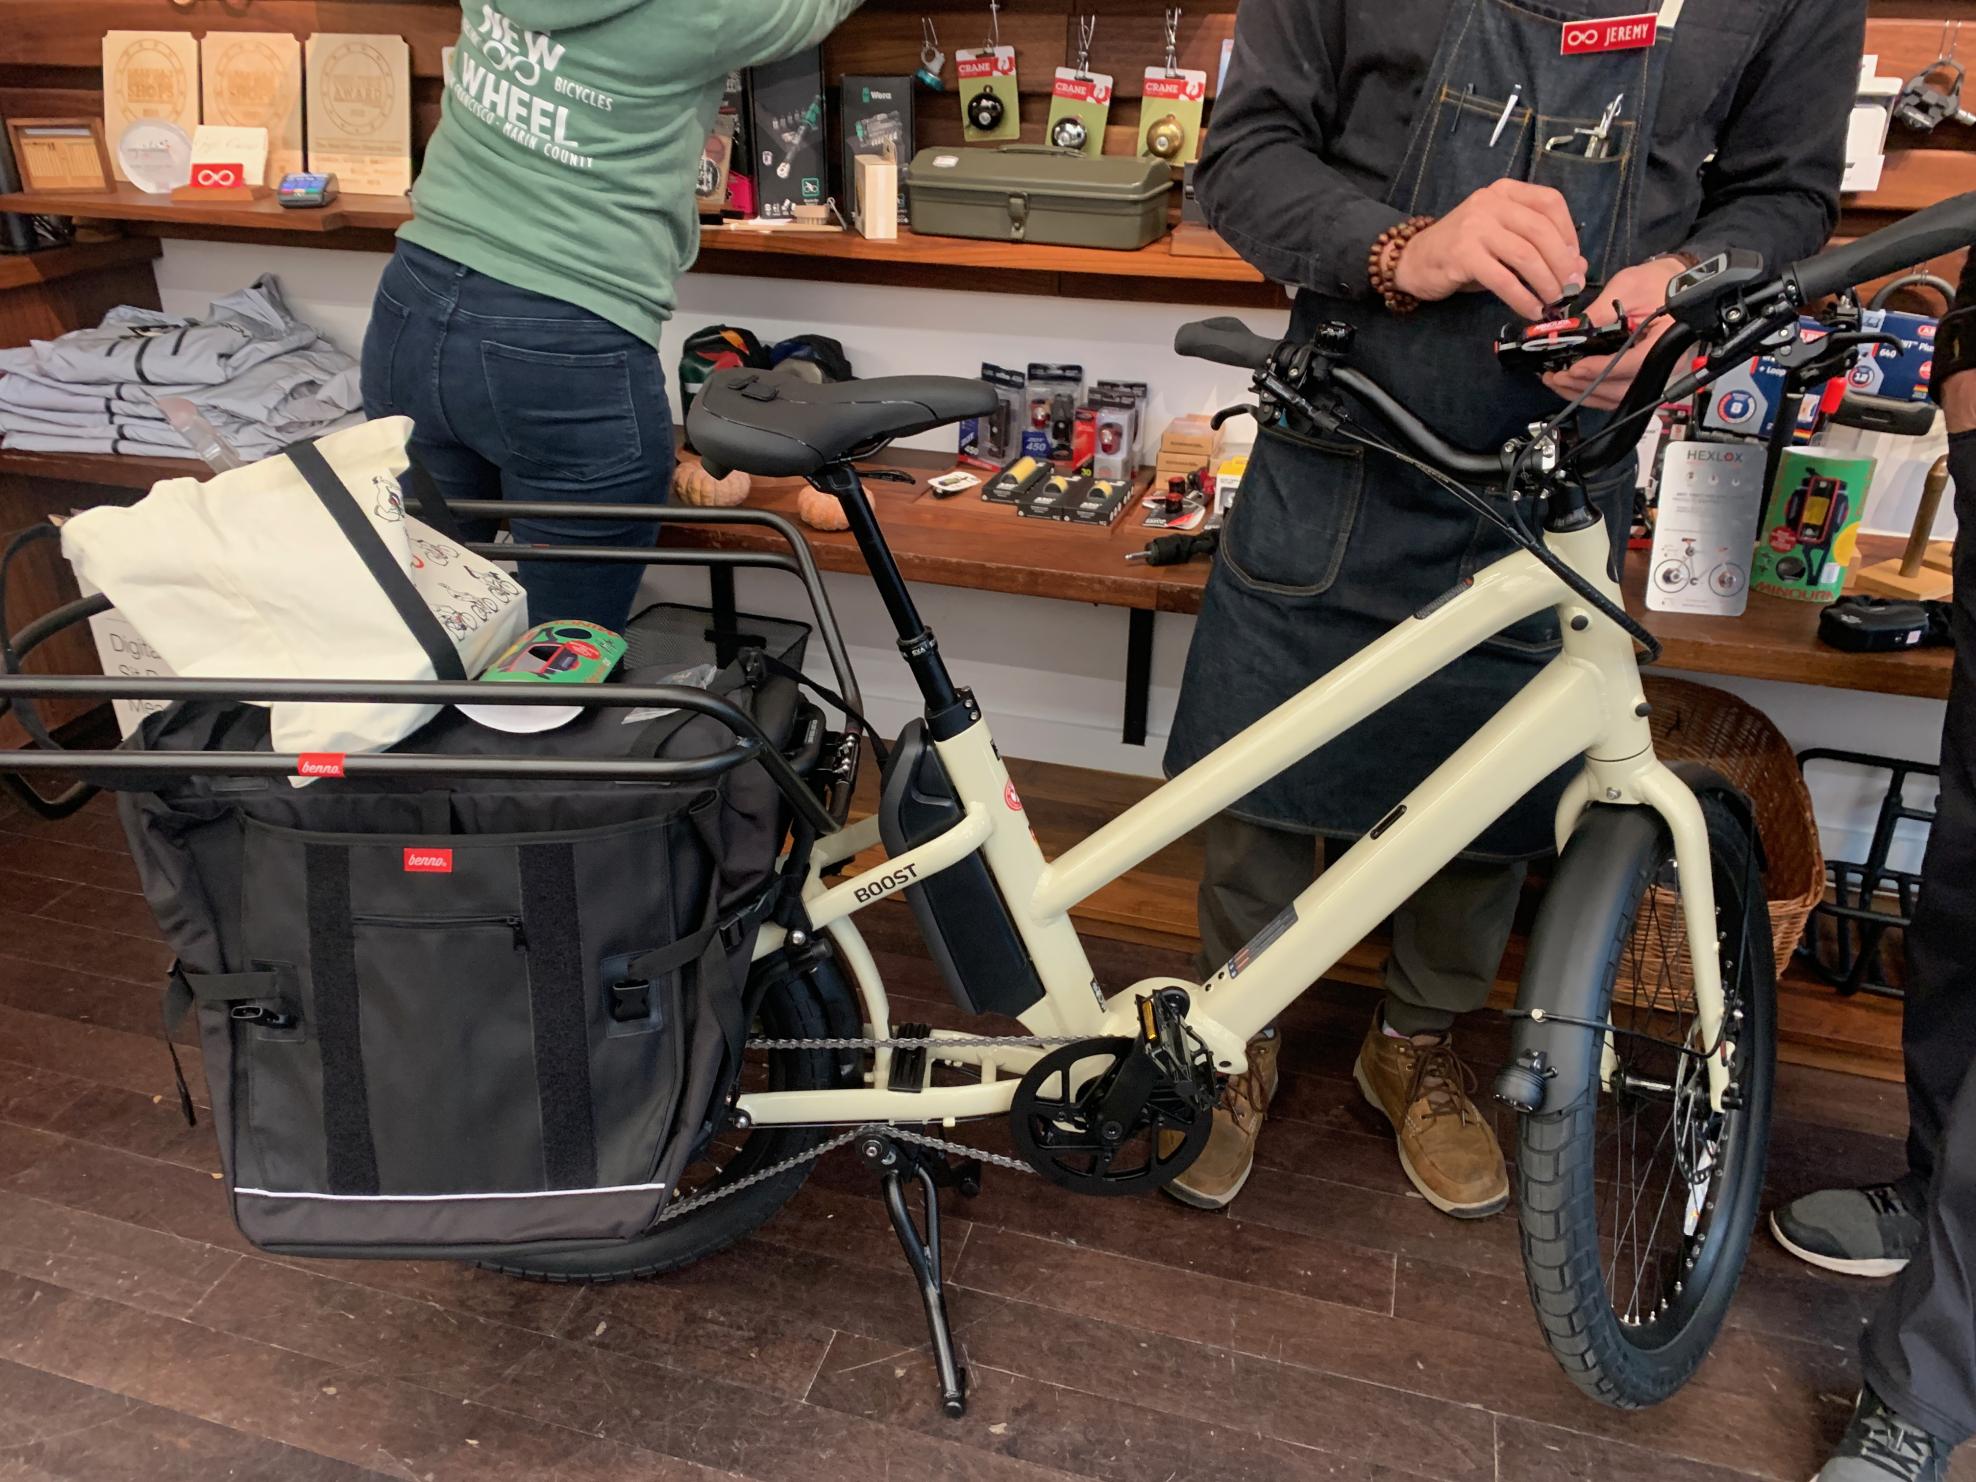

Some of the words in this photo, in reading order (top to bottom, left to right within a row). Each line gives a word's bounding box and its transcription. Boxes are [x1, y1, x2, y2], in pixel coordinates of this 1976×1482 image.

[478, 4, 566, 72] NEW
[1603, 24, 1650, 47] JEREMY
[958, 62, 991, 73] CRANE
[554, 76, 614, 112] BICYCLES
[1055, 81, 1087, 96] CRANE
[1145, 82, 1178, 94] CRANE
[462, 51, 579, 148] WHEEL
[502, 121, 539, 150] MARIN
[543, 143, 593, 168] COUNTY
[1879, 348, 1897, 359] 640
[1919, 342, 1935, 352] Plu
[1026, 442, 1047, 452] 450
[1687, 450, 1744, 463] HEXLOX
[109, 632, 162, 660] Digita
[128, 700, 165, 714] Mea
[853, 862, 918, 903] BOOST
